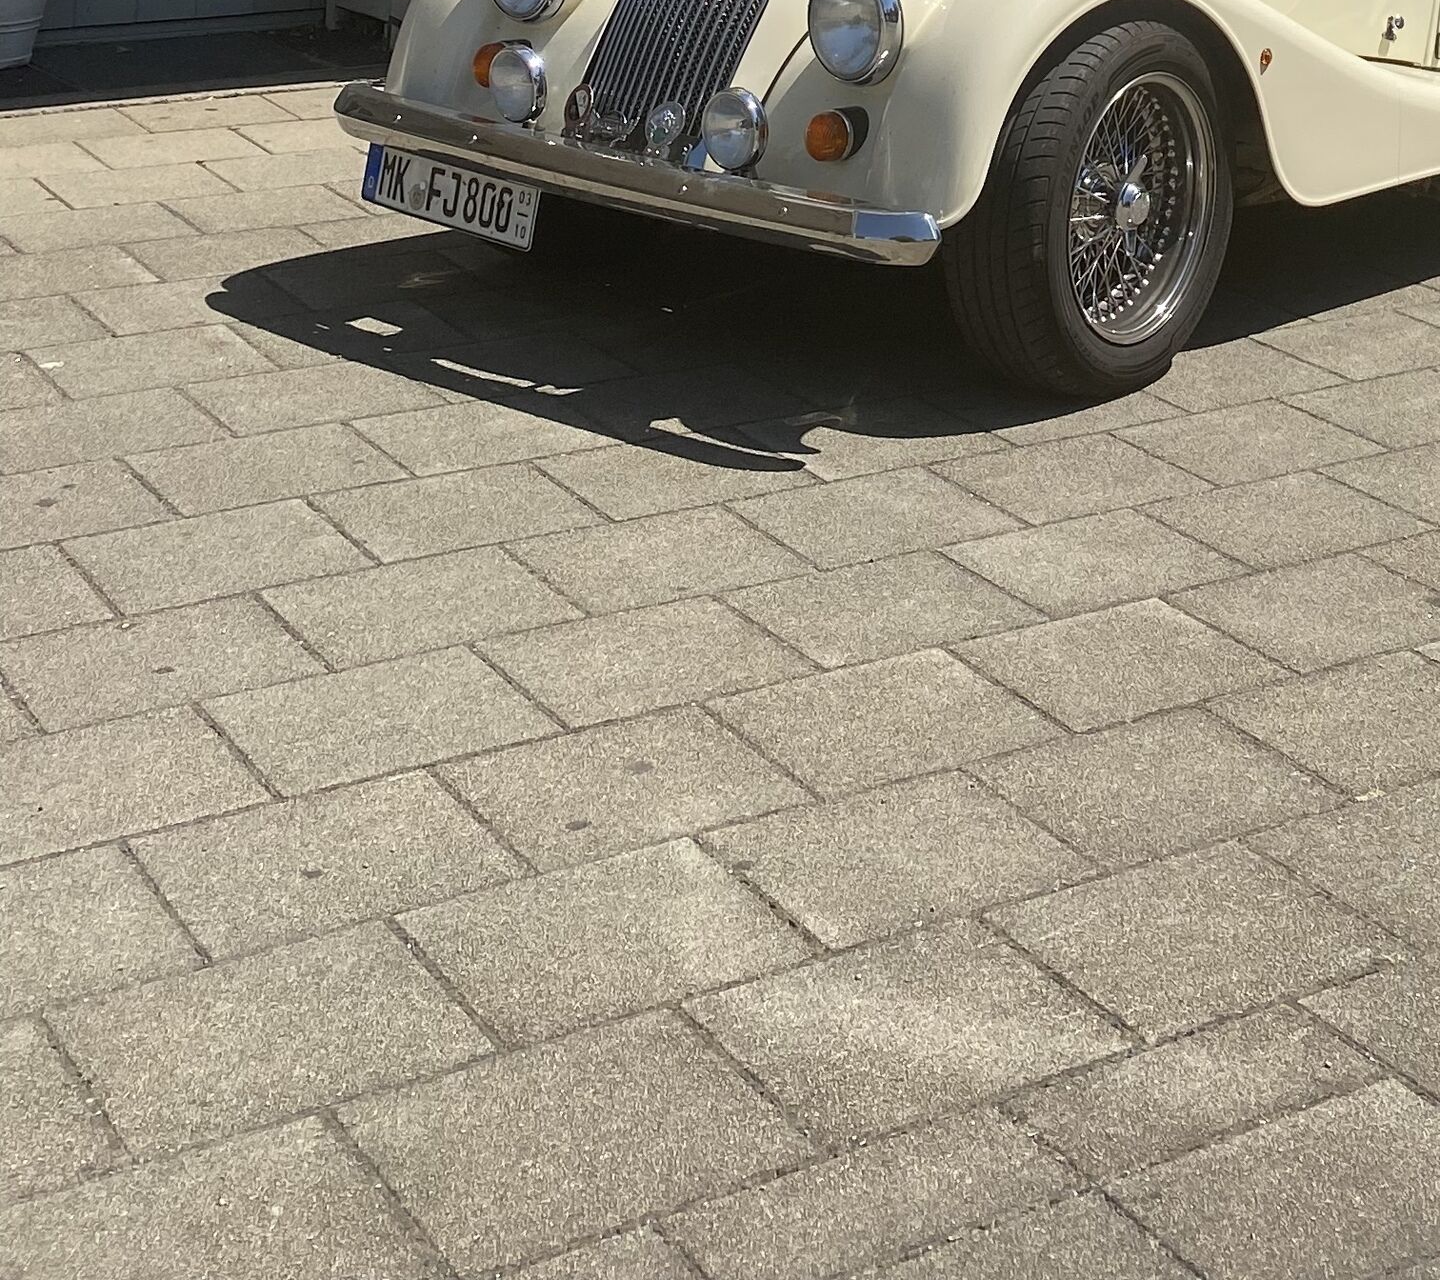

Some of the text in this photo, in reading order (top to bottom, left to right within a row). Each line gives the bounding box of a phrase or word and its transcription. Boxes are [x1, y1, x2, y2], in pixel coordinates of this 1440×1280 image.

[378, 151, 411, 204] MK
[518, 190, 532, 207] 03
[514, 223, 527, 239] 10
